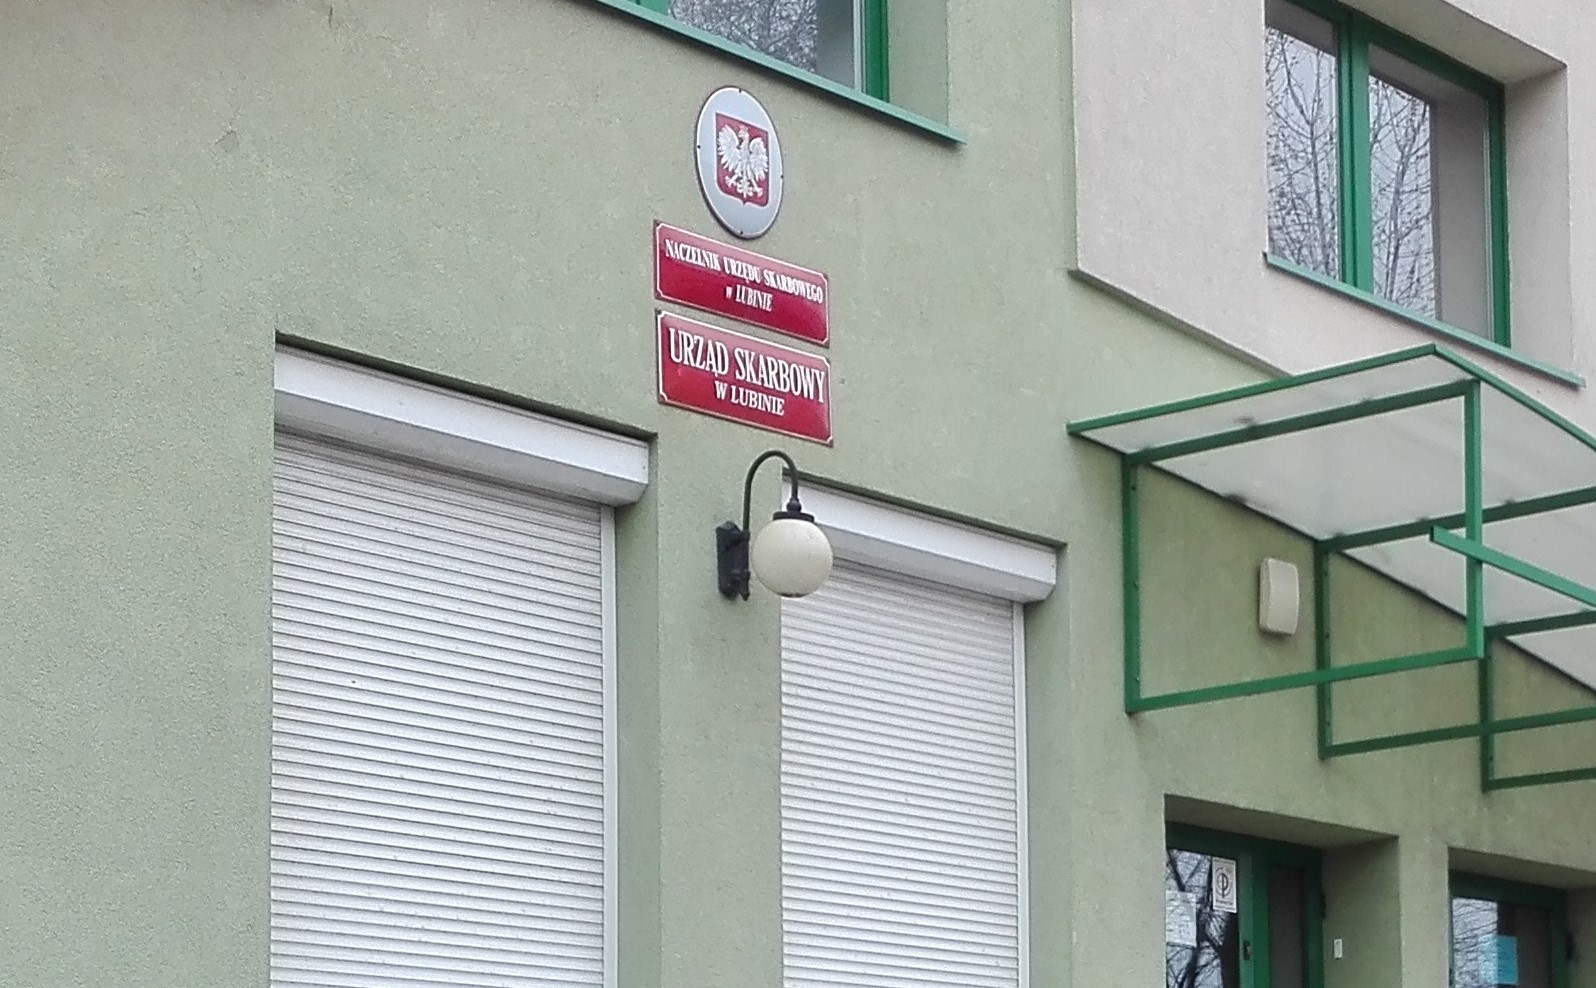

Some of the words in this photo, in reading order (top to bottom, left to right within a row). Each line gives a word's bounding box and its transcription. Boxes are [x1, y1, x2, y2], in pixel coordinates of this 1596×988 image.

[665, 238, 721, 272] NACZELNIK
[723, 256, 761, 284] URZĘDU
[763, 269, 823, 304] SKARBOWEGO
[735, 284, 773, 312] LUBINIE
[669, 328, 729, 377] URZĄD
[734, 347, 825, 403] SKARBOWY
[714, 380, 727, 400] W
[730, 384, 785, 416] LUBINIE
